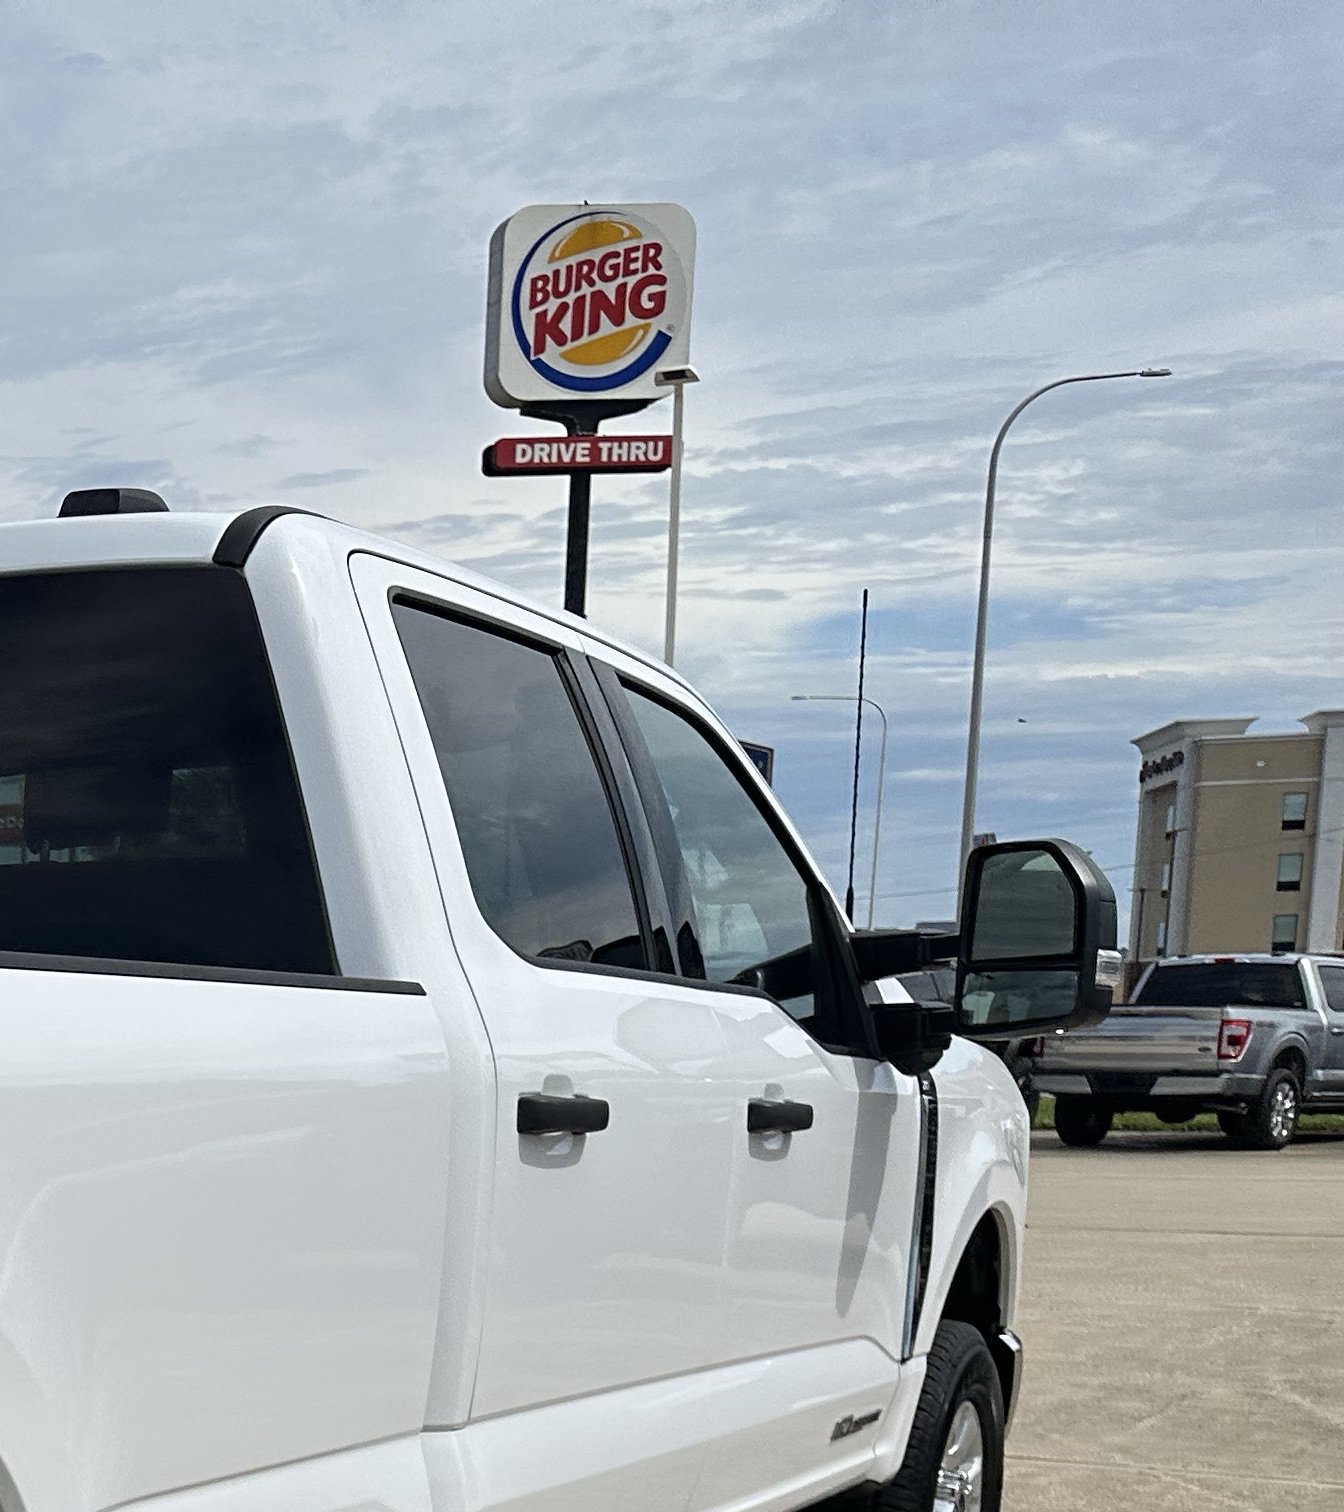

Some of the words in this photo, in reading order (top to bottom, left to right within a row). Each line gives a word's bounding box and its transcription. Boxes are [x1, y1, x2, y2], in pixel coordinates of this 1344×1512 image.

[528, 242, 663, 311] BURGER
[532, 273, 667, 357] KING
[515, 441, 590, 464] DRIVE
[598, 441, 664, 463] THRU
